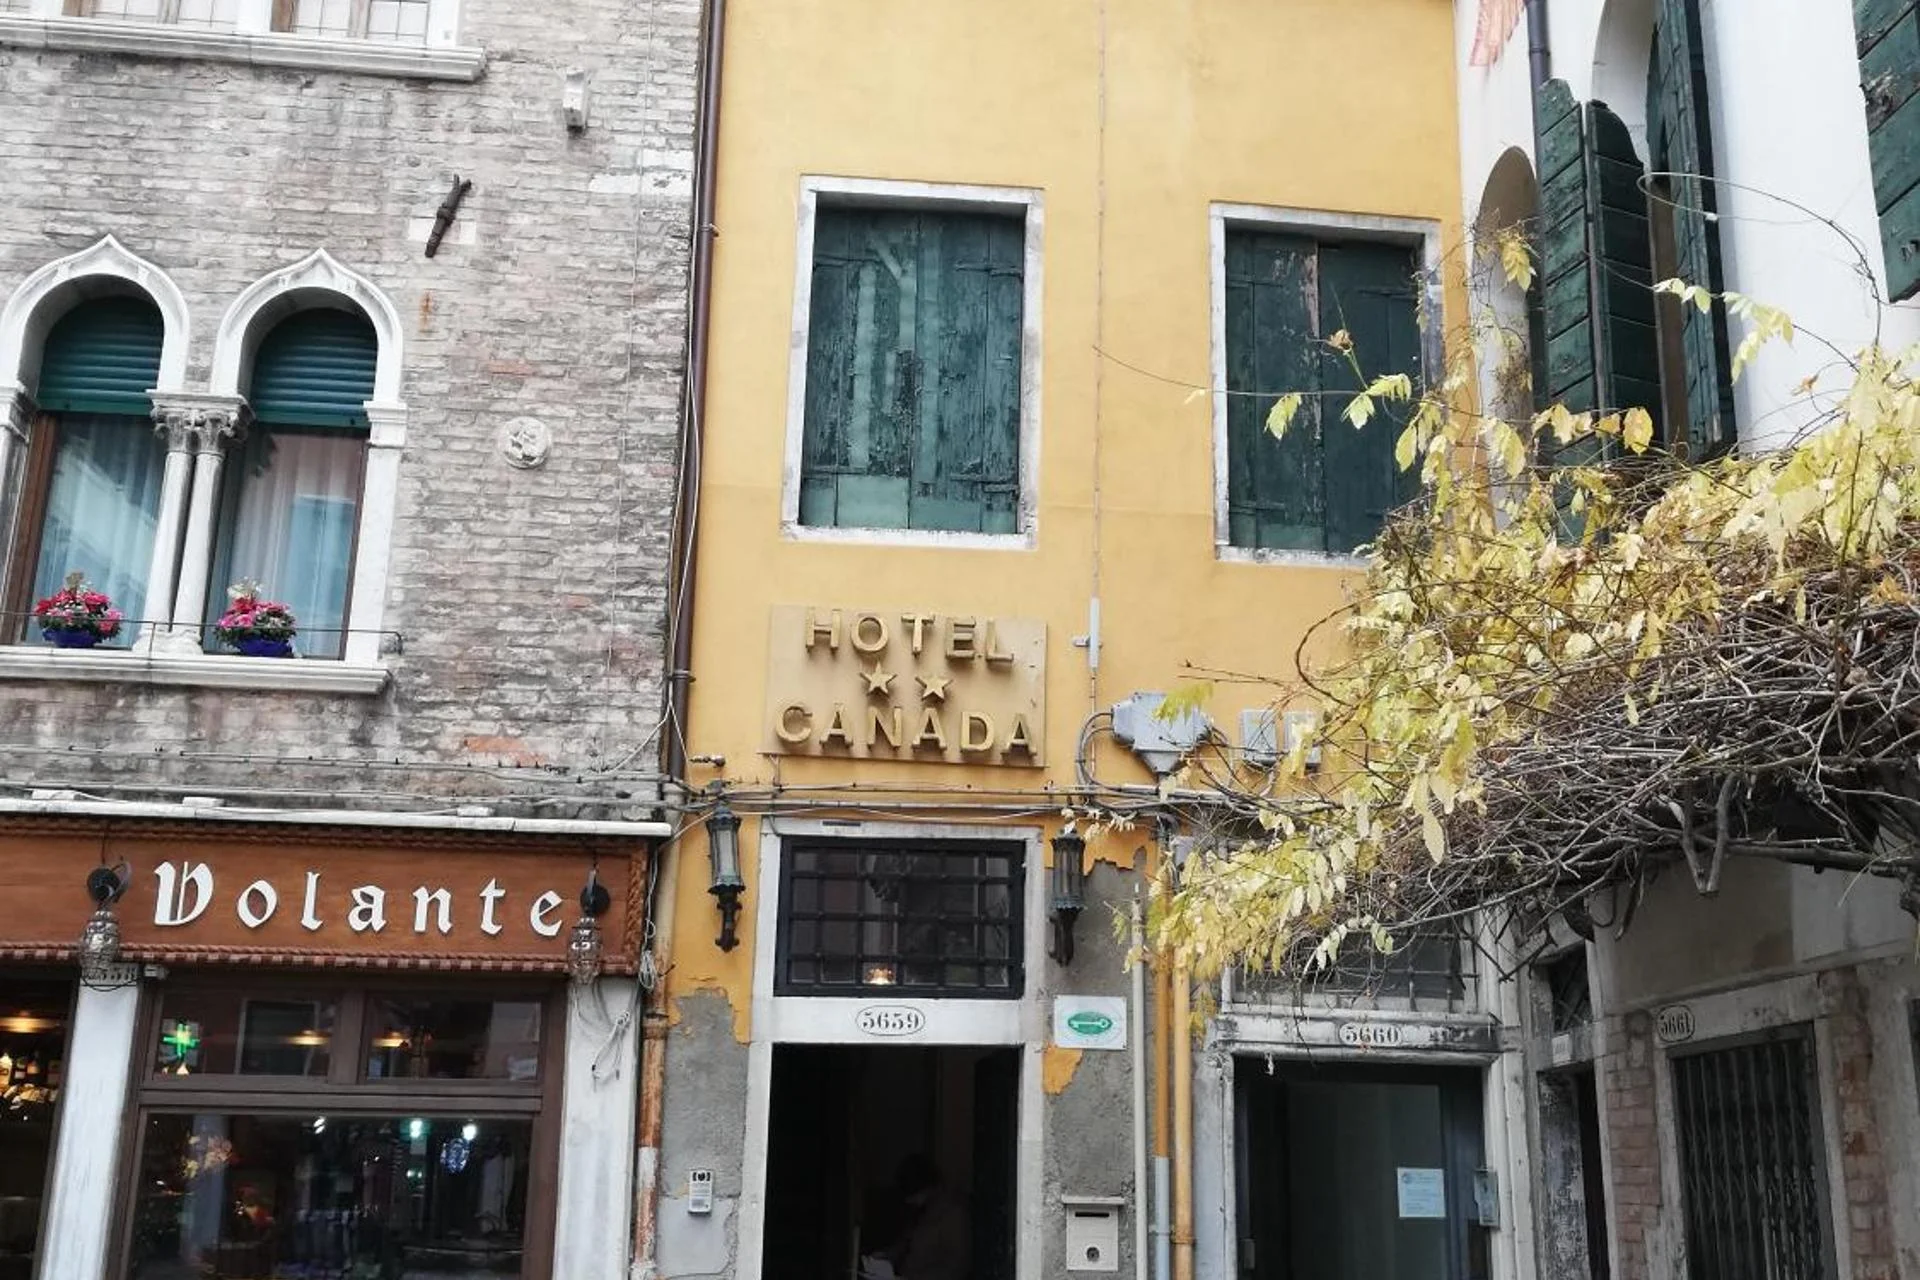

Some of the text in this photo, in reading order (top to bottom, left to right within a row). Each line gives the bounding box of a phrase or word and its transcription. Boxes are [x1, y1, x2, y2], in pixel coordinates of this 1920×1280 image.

[804, 607, 1014, 662] HOTEL
[775, 699, 1037, 757] CANADA
[153, 861, 564, 937] Volante
[863, 1011, 919, 1030] 5659
[1345, 1025, 1399, 1044] 5660
